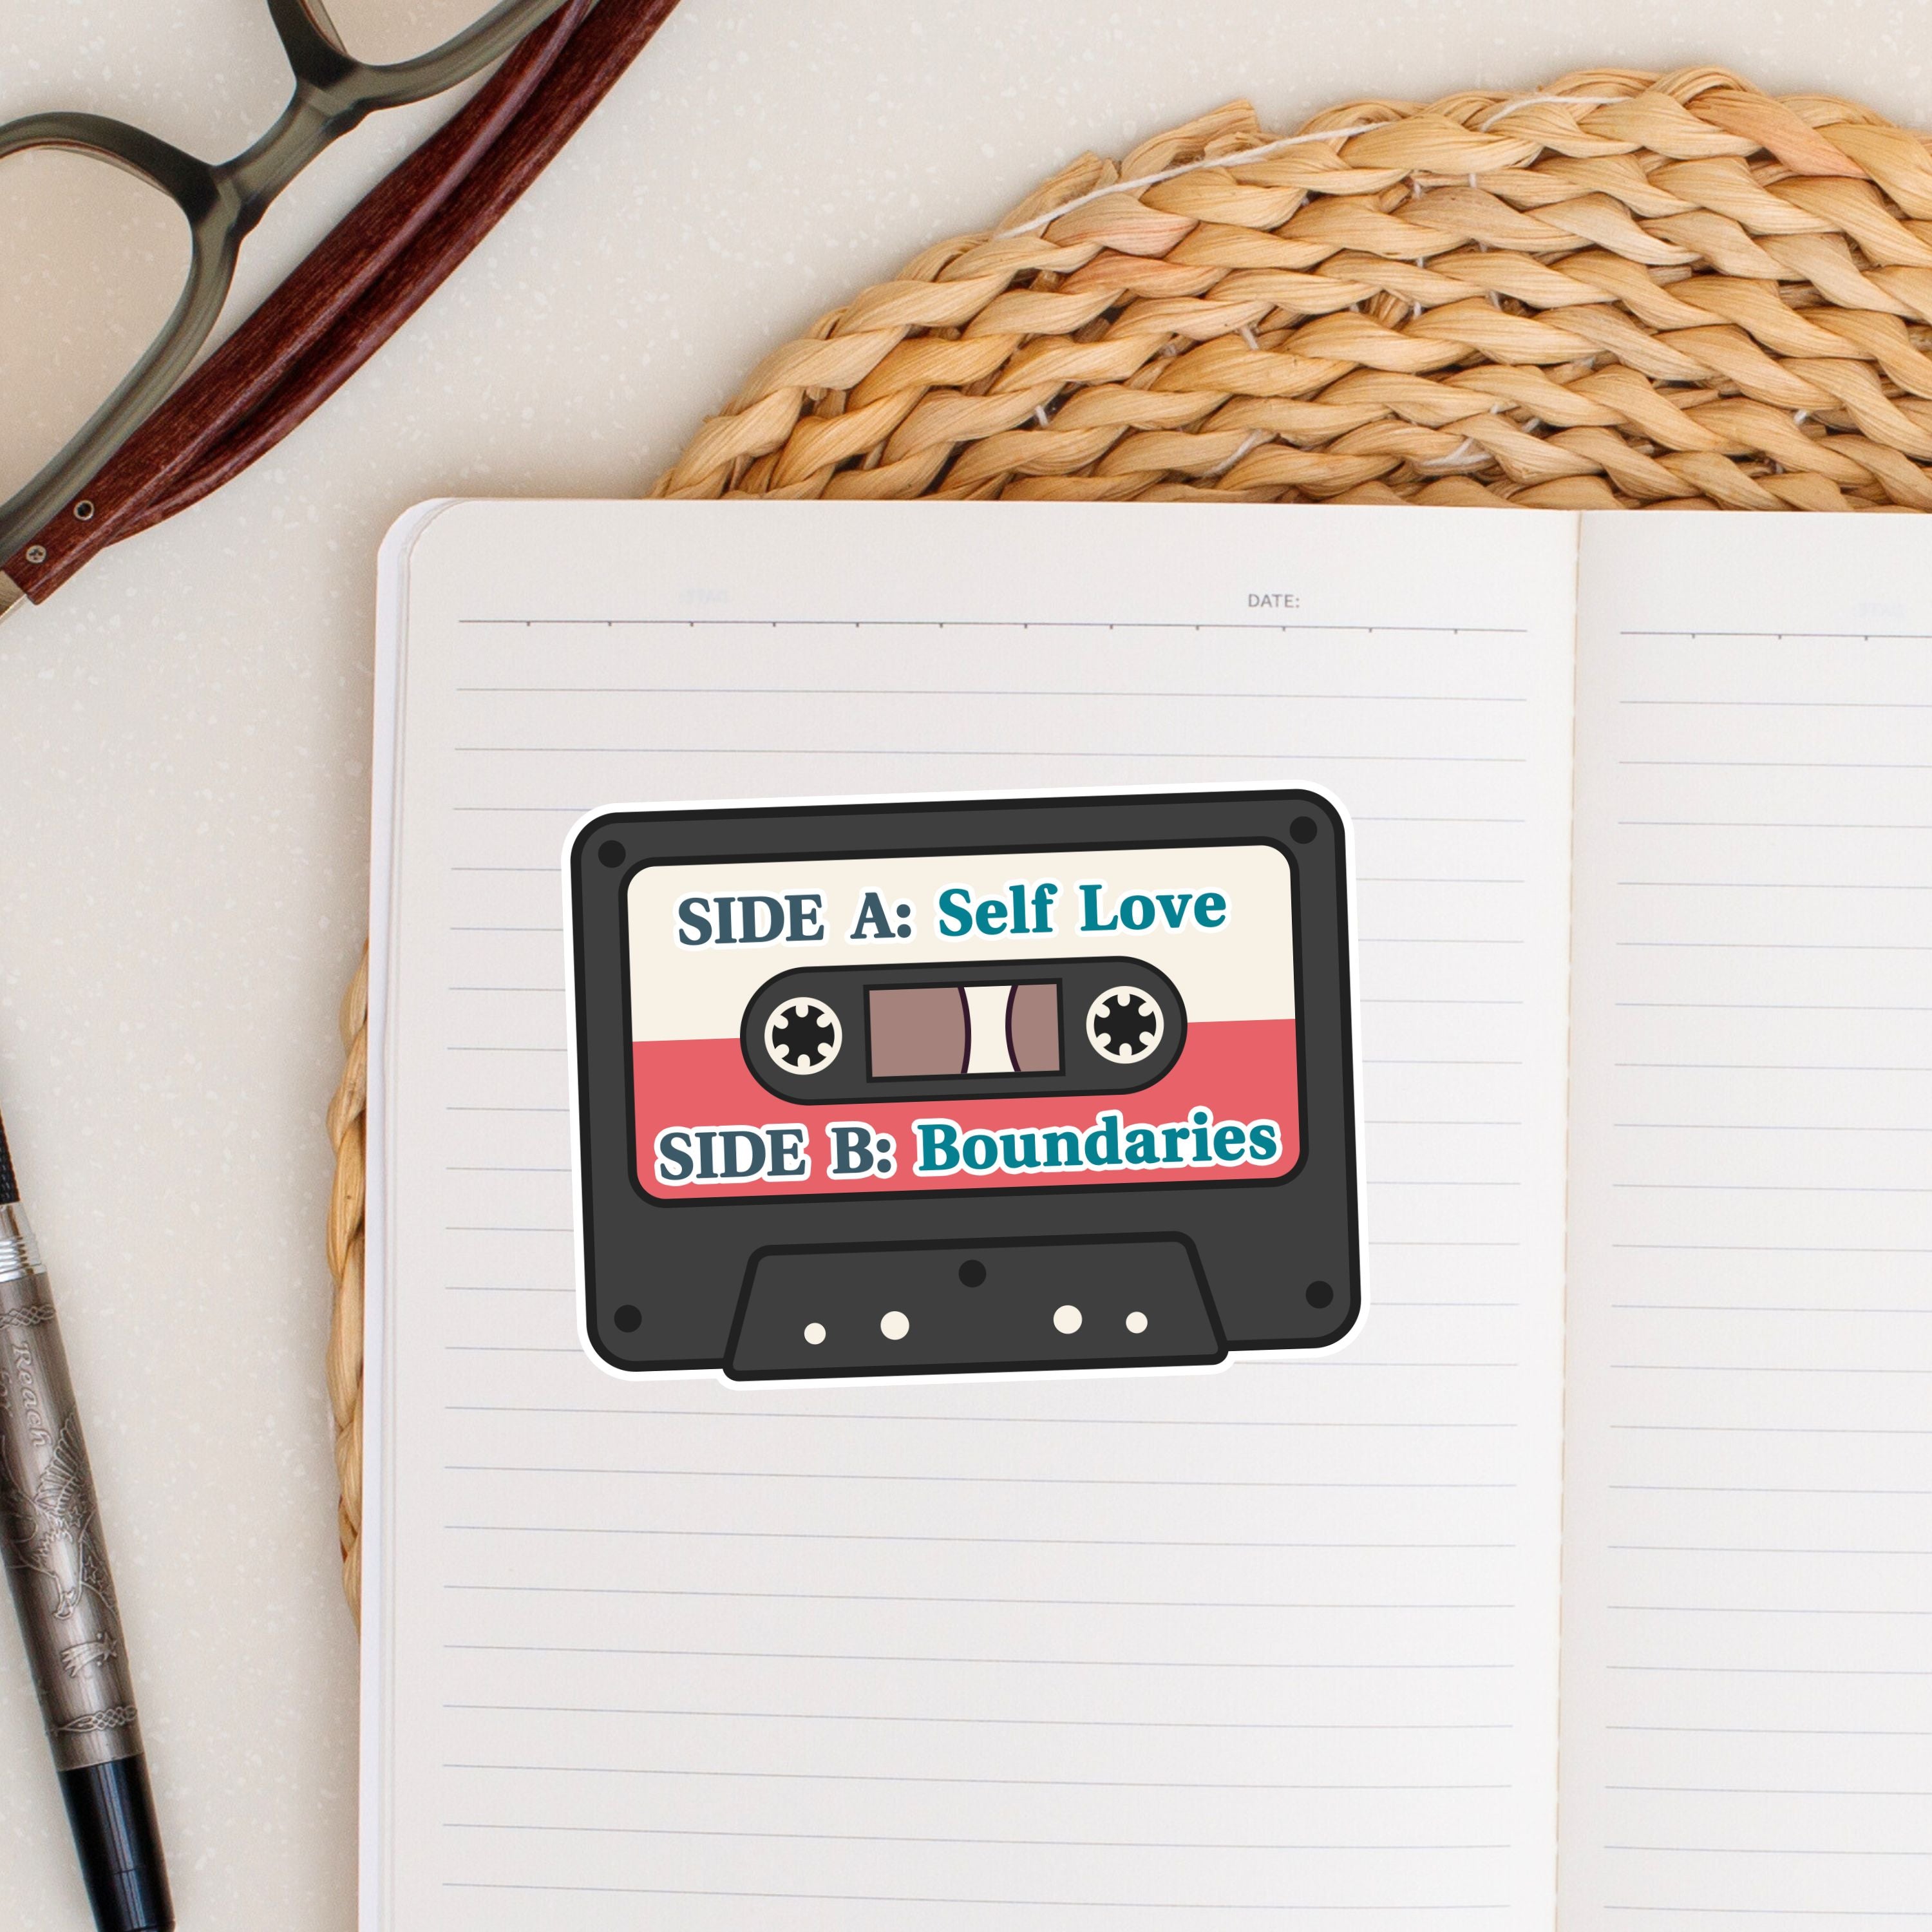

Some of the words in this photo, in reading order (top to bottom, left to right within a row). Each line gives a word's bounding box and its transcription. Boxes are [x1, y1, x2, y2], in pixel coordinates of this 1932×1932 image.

[1247, 593, 1300, 608] DATE:
[679, 894, 824, 945] SIDE
[850, 892, 911, 939] A:
[939, 883, 1058, 937] Self
[1079, 884, 1226, 931] Love
[660, 1129, 806, 1180] SIDE
[831, 1127, 891, 1174] B:
[917, 1112, 1277, 1171] Boundaries
[12, 1341, 53, 1448] Reach
